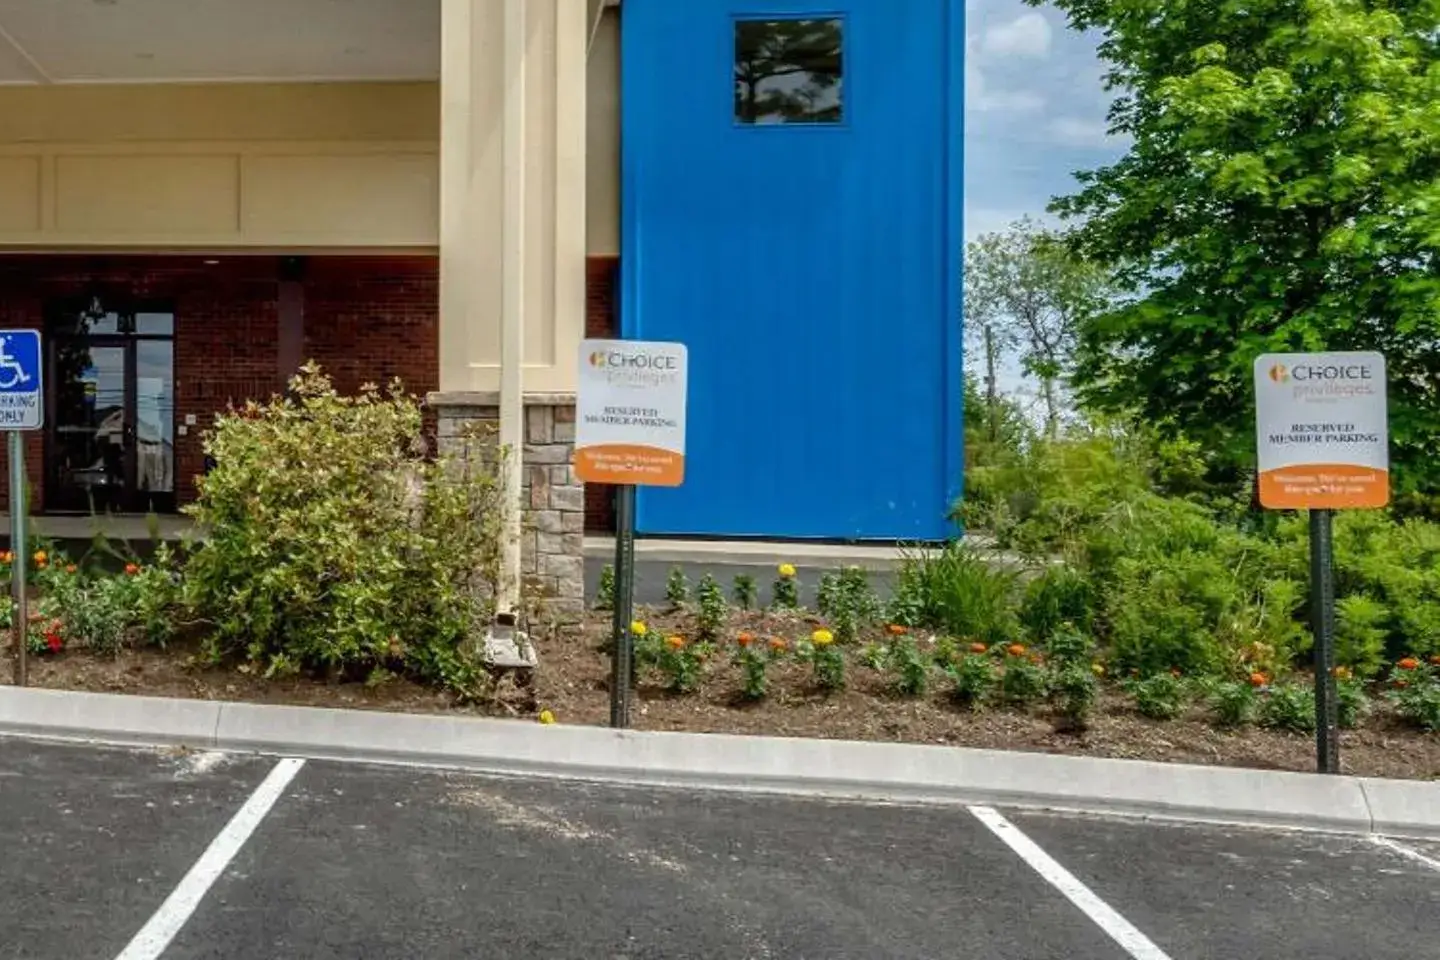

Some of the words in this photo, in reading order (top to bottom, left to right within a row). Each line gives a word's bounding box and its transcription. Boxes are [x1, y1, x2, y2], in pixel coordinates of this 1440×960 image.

[608, 352, 678, 369] CHOICE
[1291, 365, 1372, 380] CHOICE
[604, 406, 658, 418] RESERVED
[585, 414, 631, 425] MEMBER
[633, 416, 677, 428] PARKING
[1290, 424, 1355, 433] RESERVED
[1269, 434, 1322, 444] MEMBER
[1326, 433, 1378, 443] PARKING
